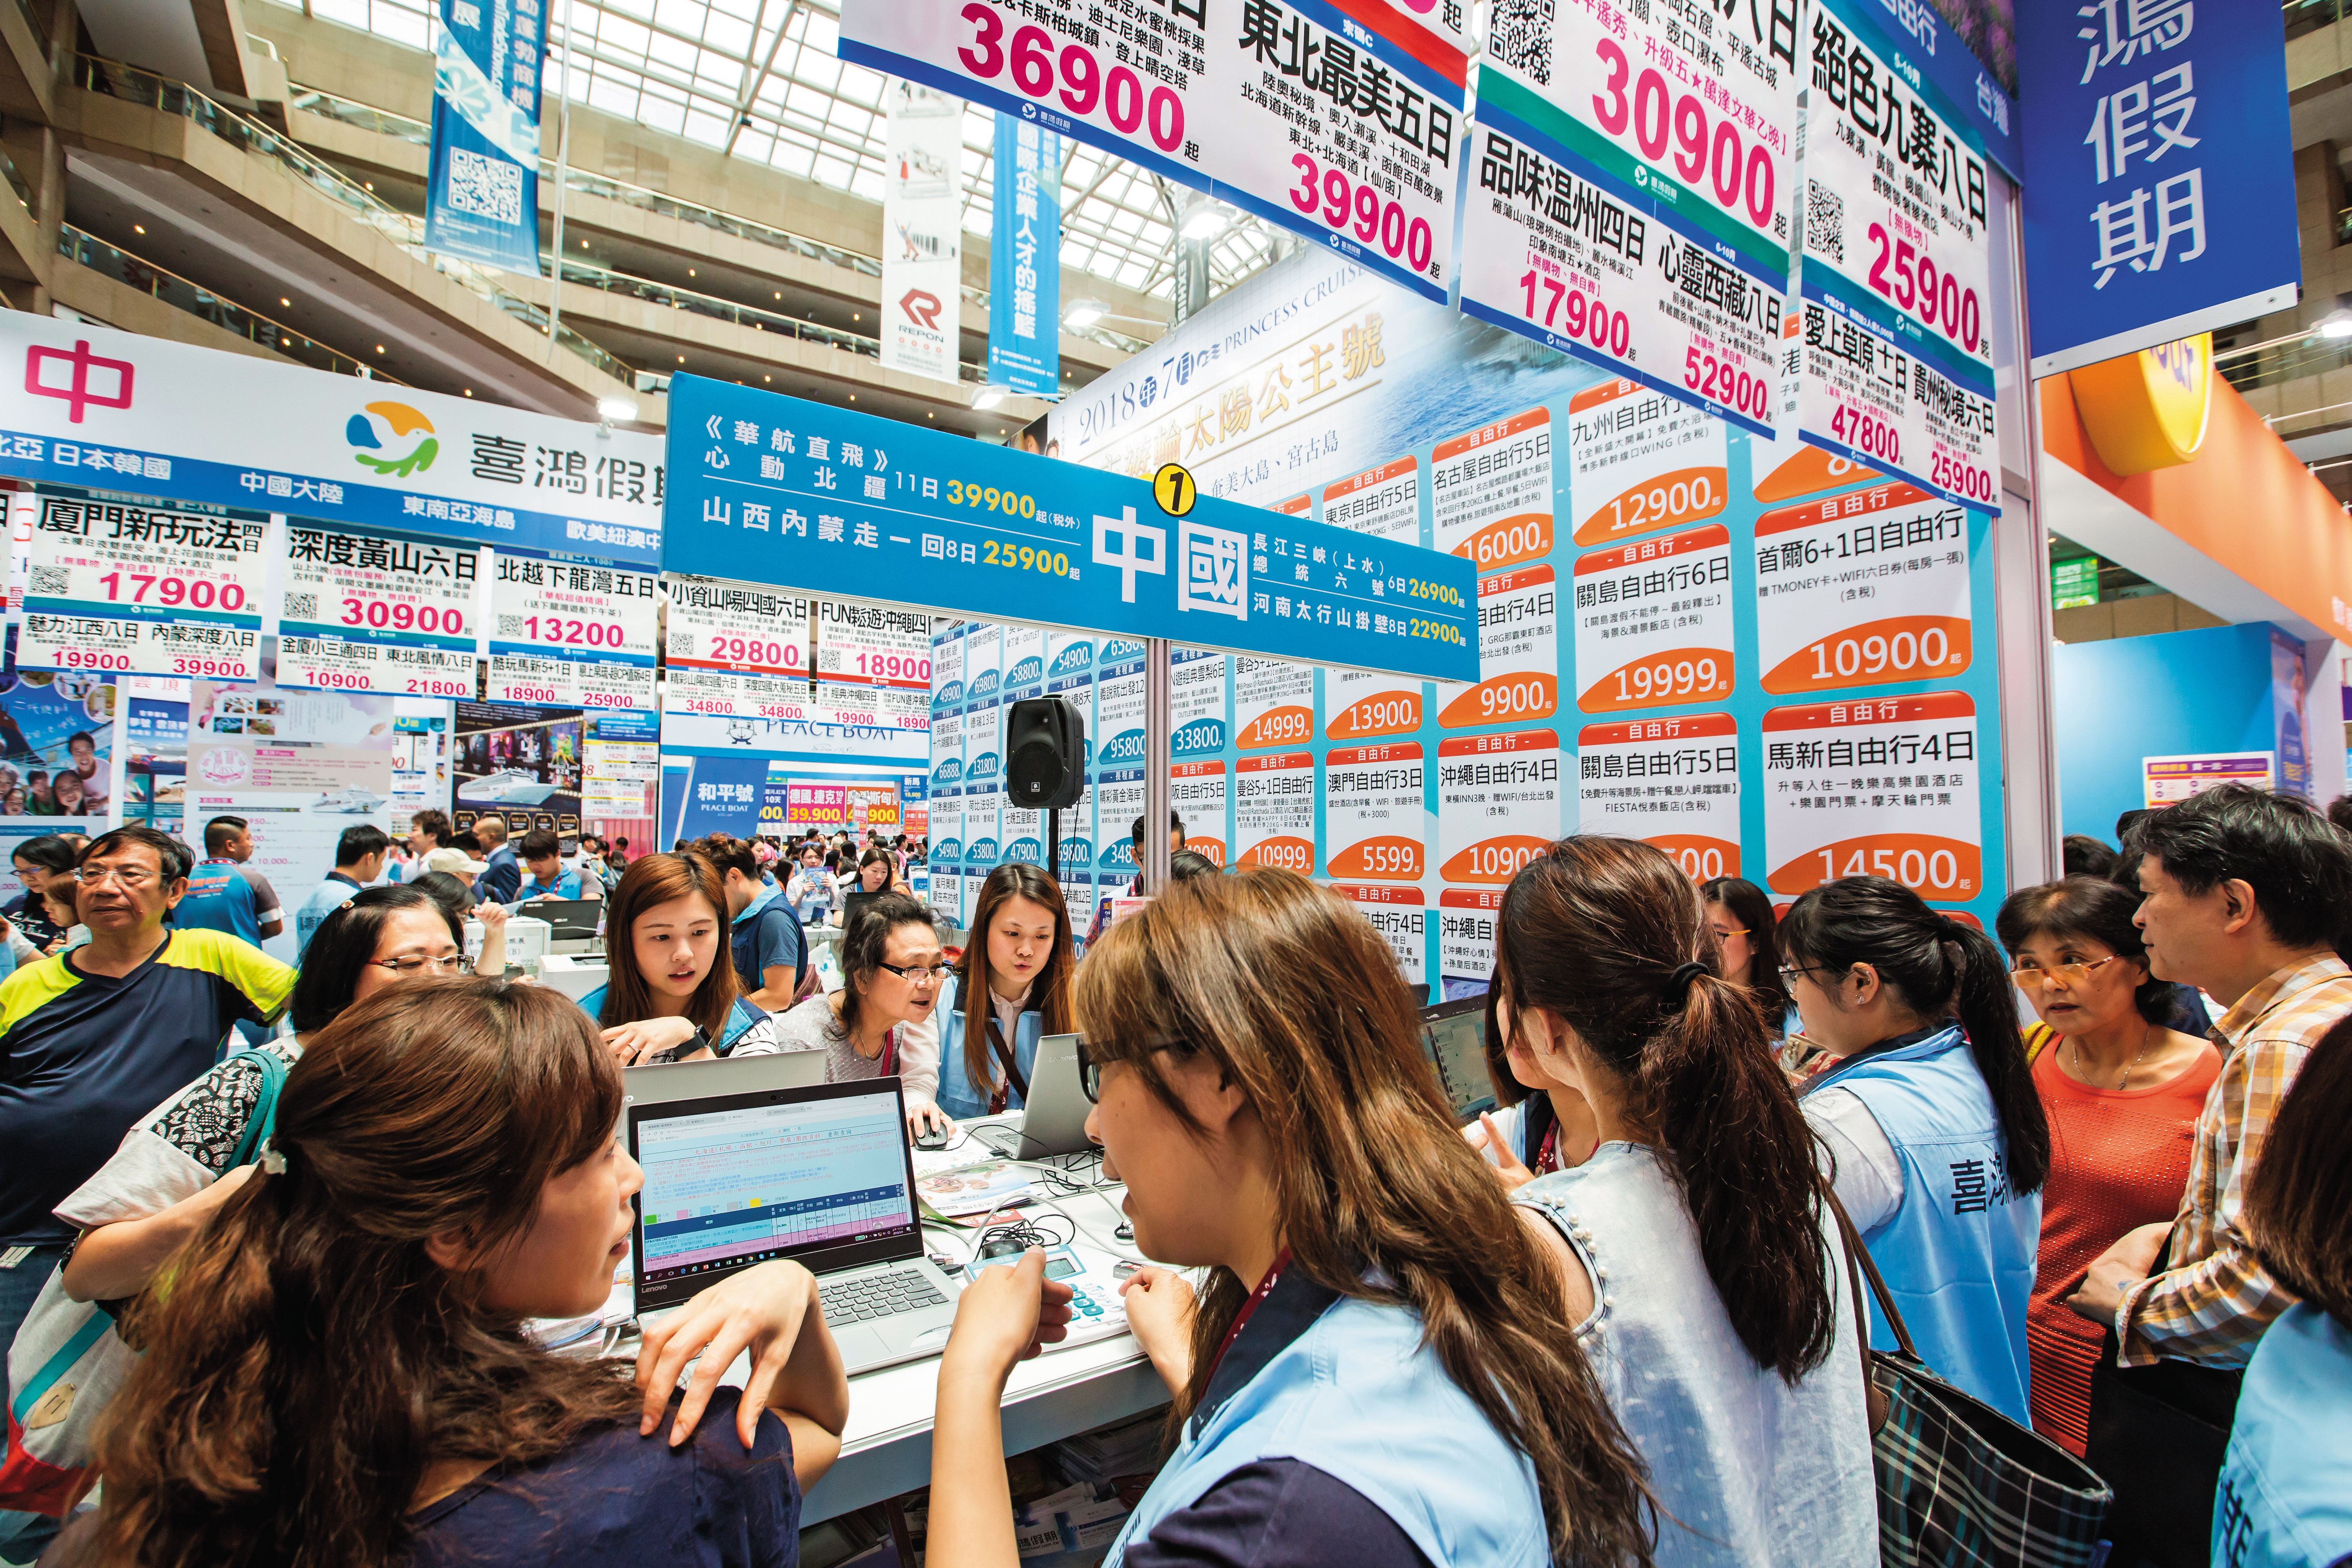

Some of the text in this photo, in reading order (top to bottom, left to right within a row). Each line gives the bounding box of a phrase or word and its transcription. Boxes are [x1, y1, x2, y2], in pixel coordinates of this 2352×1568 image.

[958, 2, 1184, 152] 36900
[1238, 0, 1453, 169] 東北最美五日
[1592, 37, 1774, 228] 30900
[1812, 8, 1987, 231] 絕色九寨八日
[1290, 153, 1432, 272] 39900
[1658, 233, 1781, 339] 心靈西藏八日
[1868, 222, 1980, 353] 25900
[1224, 294, 1298, 354] PRINCESS
[1520, 270, 1629, 357] 17900
[899, 324, 944, 343] REPON
[24, 339, 134, 425] 中
[1684, 345, 1767, 419] 52900
[705, 414, 889, 473] 《華航直飛》
[1831, 403, 1899, 464] 47800
[470, 432, 666, 507] 喜鴻假
[1434, 432, 1550, 490] 名古屋自由行5日
[1931, 450, 1991, 502] 25900
[53, 442, 172, 481] 日本韓國
[240, 471, 343, 505] 中國大陸
[402, 495, 516, 530] 東南亞海島
[704, 446, 887, 501] 心動北疆
[946, 479, 1036, 520] 39900
[1609, 476, 1711, 531] 12900
[288, 528, 478, 582] 深度黃山六日
[1757, 507, 1964, 575] 首爾6+1日自由行
[983, 539, 1069, 578] 25900
[1092, 505, 1247, 622] 中國
[100, 571, 245, 611] 17900
[497, 557, 654, 599] 北越下龍灣五日
[1409, 577, 1459, 606] 26900
[1577, 555, 1729, 609] 關島自由行6日
[341, 598, 463, 635] 30900
[524, 616, 624, 648] 13200
[1410, 618, 1459, 645] 22900
[51, 651, 130, 670] 19900
[173, 659, 246, 677] 39900
[386, 647, 472, 668] 東北風情八日
[710, 637, 798, 667] 29800
[856, 653, 931, 680] 18900
[1058, 646, 1088, 670] 54900
[1810, 627, 1948, 679] 10900
[305, 671, 369, 689] 10900
[406, 679, 466, 696] 21800
[975, 673, 997, 693] 69800
[1013, 661, 1038, 683] 58800
[1615, 658, 1717, 701] 19999
[502, 686, 555, 702] 18900
[584, 693, 633, 708] 25900
[686, 699, 732, 714] 34800
[940, 684, 960, 702] 49900
[1481, 681, 1544, 716] 9900
[759, 705, 802, 719] 34800
[834, 712, 873, 725] 19900
[1254, 713, 1305, 742] 14999
[1349, 699, 1412, 731] 13900
[1176, 725, 1219, 751] 33800
[1768, 730, 1974, 771] 馬新自由行4日
[939, 763, 959, 778] 66888
[1441, 758, 1557, 788] 沖繩自由行4日
[1581, 747, 1737, 780] 關島自由行5日
[698, 783, 755, 803] 和平號
[1328, 768, 1422, 793] 澳門自由行3日
[788, 807, 842, 823] 39,900
[938, 843, 958, 858] 54900
[973, 843, 995, 859] 53800
[1010, 843, 1037, 860] 47900
[1254, 845, 1305, 869] 10999
[1363, 846, 1414, 873] 5599
[641, 1284, 667, 1294] Lenovo
